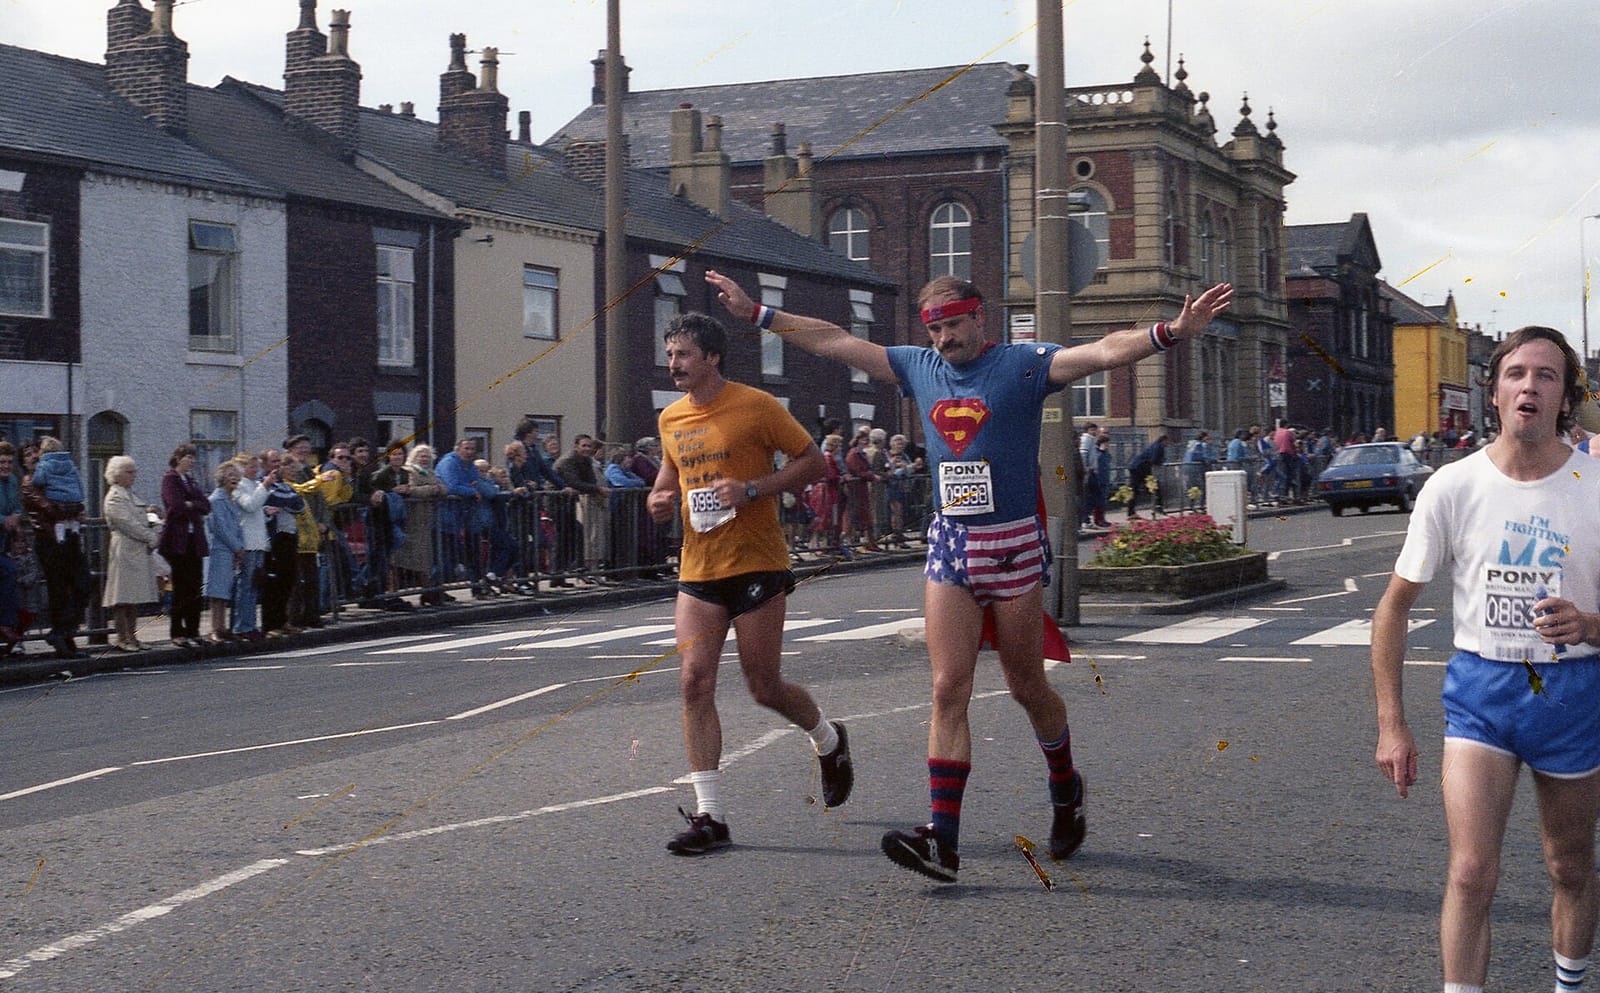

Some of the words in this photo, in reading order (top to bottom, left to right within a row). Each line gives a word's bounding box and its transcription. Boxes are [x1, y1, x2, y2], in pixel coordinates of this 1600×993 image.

[681, 450, 731, 468] Systems
[944, 465, 985, 475] PONY
[1529, 515, 1550, 528] I'M
[1504, 520, 1569, 545] FIGHTING
[1487, 570, 1554, 585] PONY
